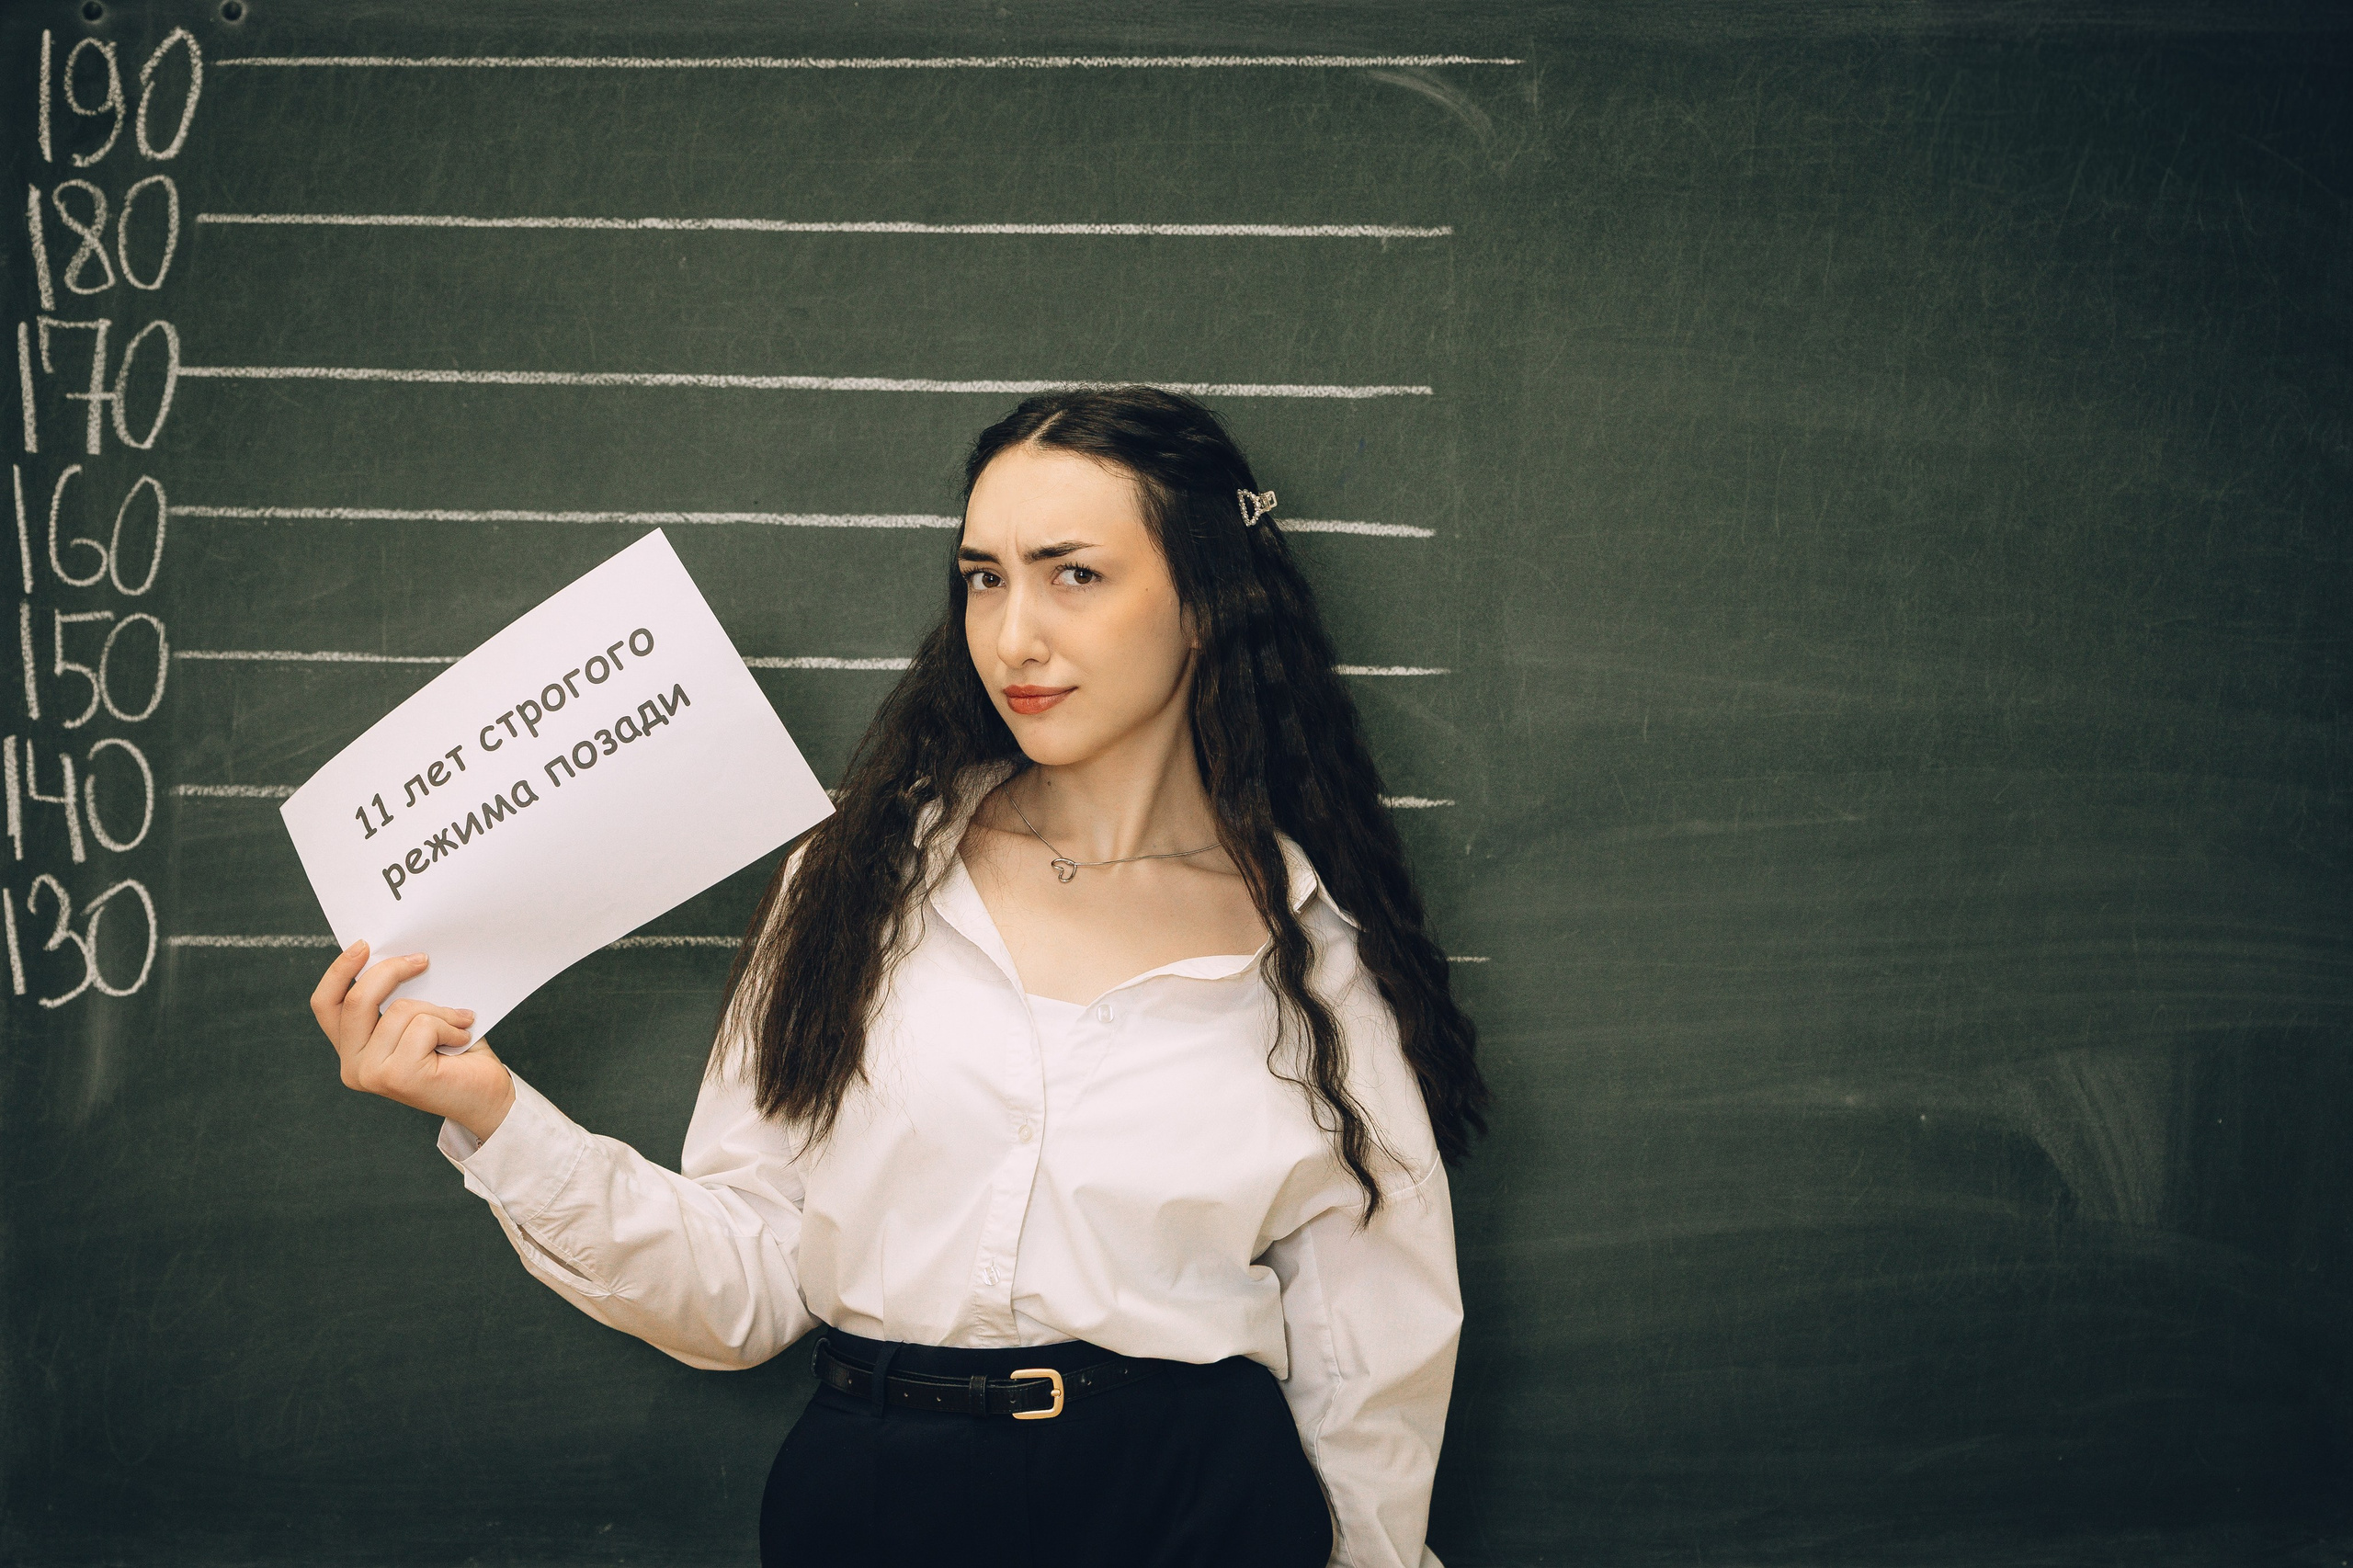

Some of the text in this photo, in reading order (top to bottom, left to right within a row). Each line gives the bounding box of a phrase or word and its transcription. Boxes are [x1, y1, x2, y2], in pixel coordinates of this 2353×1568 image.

[39, 27, 202, 167] 190
[28, 175, 179, 311] 180
[17, 315, 179, 455] 170
[13, 463, 166, 596] 160
[19, 598, 168, 728] 150
[4, 735, 154, 864] 140
[354, 628, 655, 839] 11 лет строгого
[381, 683, 691, 901] режима позади
[3, 873, 156, 1007] 130
